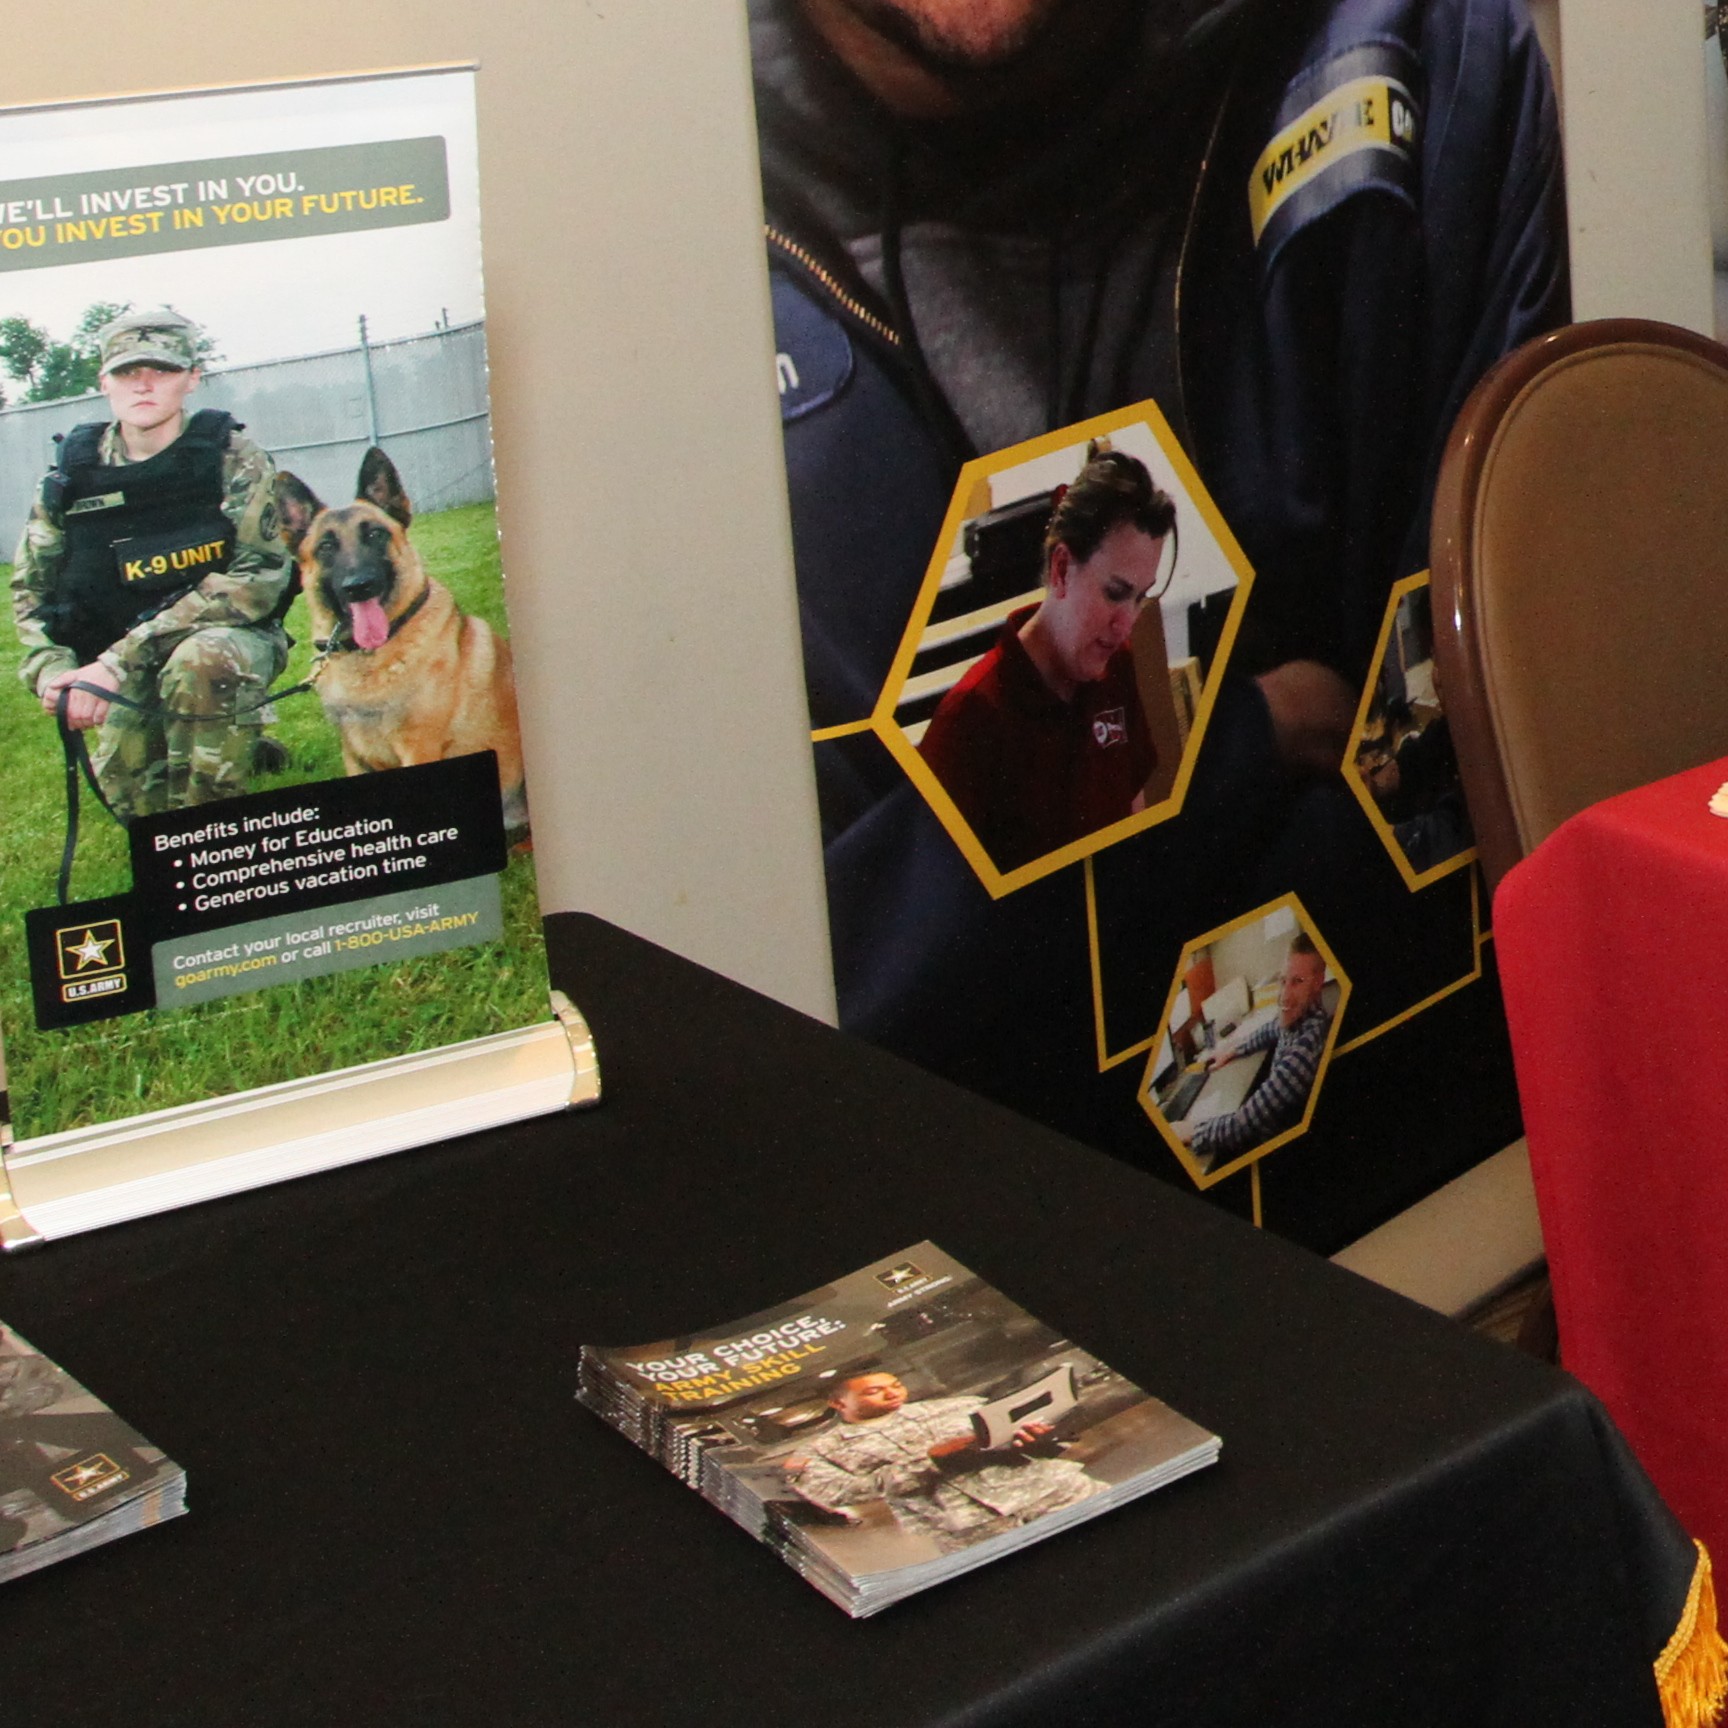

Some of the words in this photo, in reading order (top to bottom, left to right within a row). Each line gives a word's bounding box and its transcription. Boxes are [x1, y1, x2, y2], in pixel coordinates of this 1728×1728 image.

[0, 225, 46, 250] OU
[56, 213, 163, 245] INVEST
[174, 208, 203, 230] IN
[212, 199, 294, 225] YOUR
[302, 184, 424, 216] FUTURE.
[81, 183, 189, 215] INVEST
[198, 178, 229, 202] IN
[235, 173, 304, 196] YOU.
[125, 555, 168, 581] K-9
[171, 540, 225, 570] UNIT
[154, 822, 238, 852] Benefits
[243, 804, 321, 833] include:
[190, 843, 257, 870] Money
[262, 833, 290, 853] for
[296, 815, 394, 848] Education
[192, 849, 346, 894] Comprehensive
[350, 835, 412, 858] health
[417, 826, 458, 846] care
[194, 880, 290, 913] Generous
[295, 862, 379, 891] vacation
[383, 852, 427, 872] time
[173, 945, 239, 971] Contact
[243, 936, 281, 958] your
[286, 925, 324, 946] local
[328, 913, 402, 940] recruiter,
[405, 902, 440, 922] visit
[174, 954, 277, 990] goarmy.com
[281, 947, 299, 964] or
[303, 939, 331, 960] call
[335, 910, 479, 951] 1-800-USA-ARMY
[626, 1352, 706, 1374] YOUR
[713, 1315, 827, 1358] CHOICE,
[638, 1362, 720, 1383] YOUR
[724, 1319, 847, 1367] FUTURE:
[654, 1370, 732, 1394] ARMY
[742, 1343, 826, 1375] SKILL
[661, 1364, 802, 1402] TRAINING
